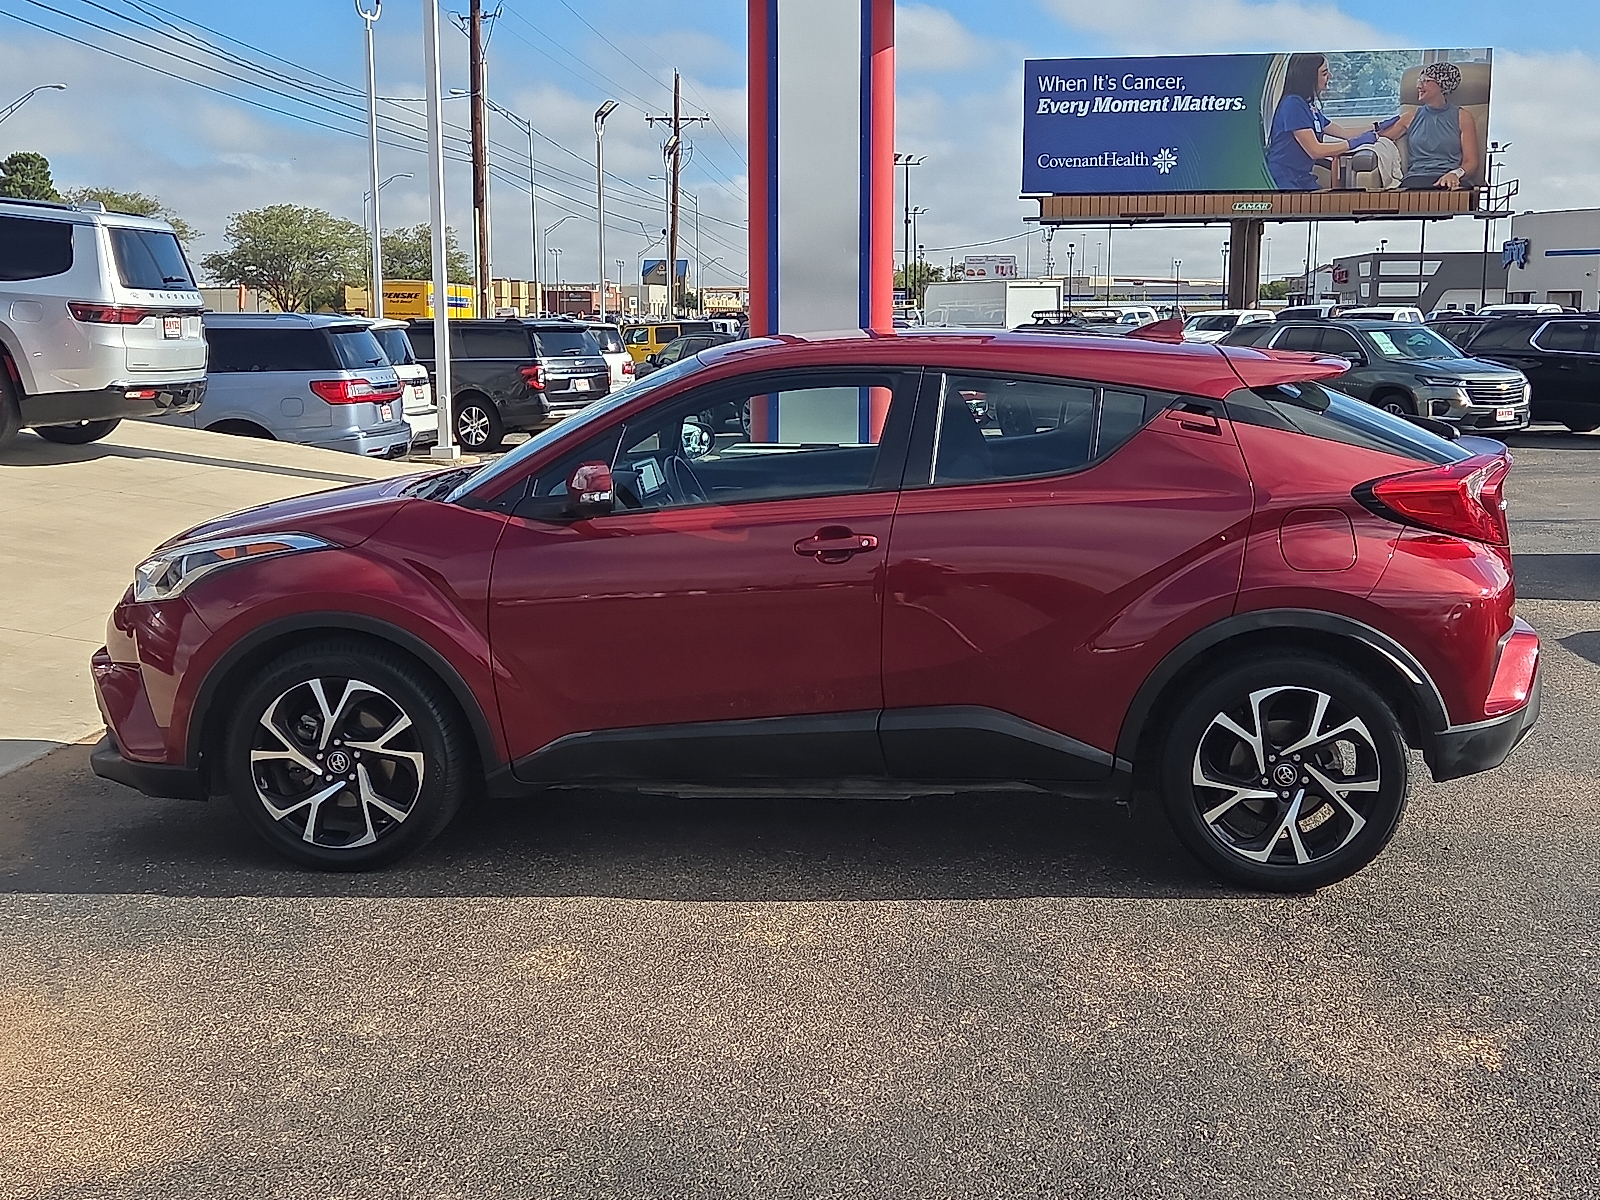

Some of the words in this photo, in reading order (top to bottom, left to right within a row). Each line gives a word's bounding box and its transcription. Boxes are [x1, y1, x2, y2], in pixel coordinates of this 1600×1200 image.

[1038, 75, 1087, 92] When
[1093, 74, 1117, 91] It's
[1122, 73, 1186, 91] Cancer,
[1036, 98, 1090, 117] Every
[1092, 96, 1170, 113] Moment
[1171, 95, 1247, 111] Matters.
[1037, 151, 1149, 169] CovenantHealth
[382, 292, 421, 300] PENSKE
